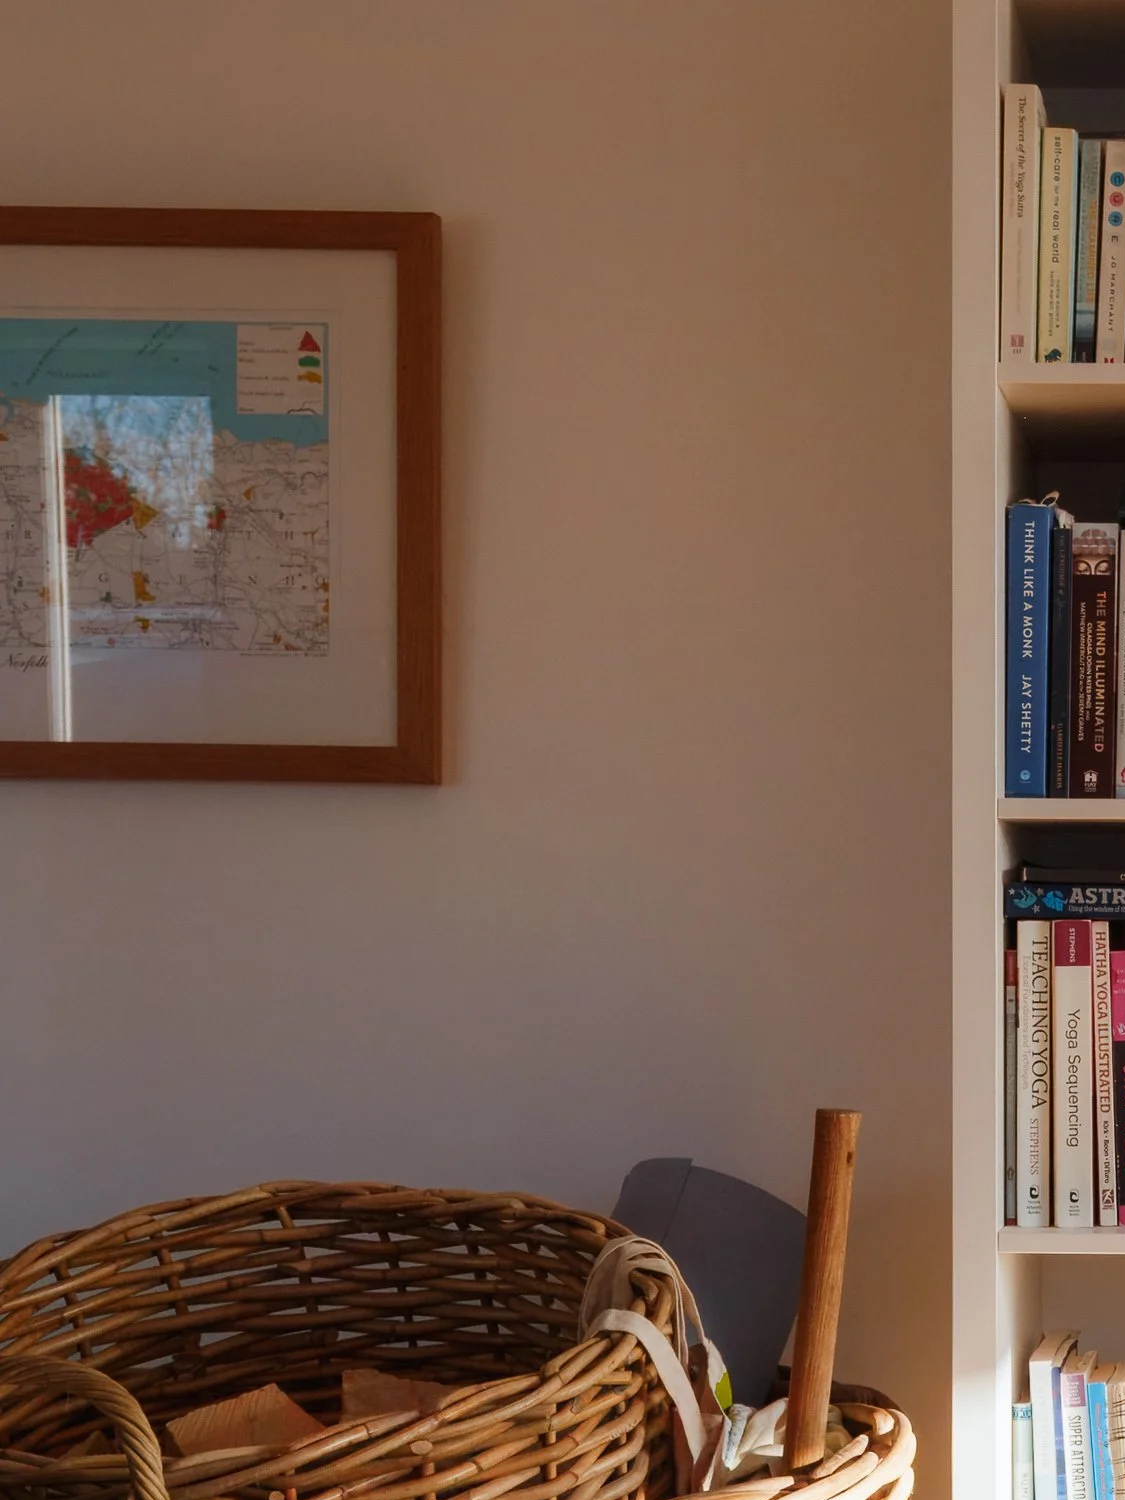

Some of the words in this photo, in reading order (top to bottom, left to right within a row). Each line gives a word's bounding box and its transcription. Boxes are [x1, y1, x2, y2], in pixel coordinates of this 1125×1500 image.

[1017, 97, 1026, 112] The
[1017, 115, 1027, 141] Secret
[1017, 143, 1027, 152] of
[1017, 155, 1026, 169] the
[1015, 172, 1026, 192] Yoga
[1017, 194, 1025, 218] Sutra
[1023, 521, 1035, 563] THINK
[1023, 568, 1034, 597] LIKE
[1023, 602, 1033, 612] A
[1096, 591, 1106, 616] THE
[1022, 616, 1033, 659] MONK
[1096, 621, 1106, 656] MIND
[1021, 675, 1032, 698] JAY
[1094, 659, 1105, 752] ILLUMINATED
[1020, 703, 1032, 754] SHETTY
[1095, 932, 1106, 978] HATHA
[1031, 936, 1048, 1042] TEACHING
[1097, 982, 1107, 1020] YOGA
[1066, 1009, 1081, 1049] Yoga
[1031, 1049, 1048, 1110] YOGA
[1097, 1023, 1110, 1113] ILLUSTRATED
[1066, 1055, 1082, 1147] Sequencing
